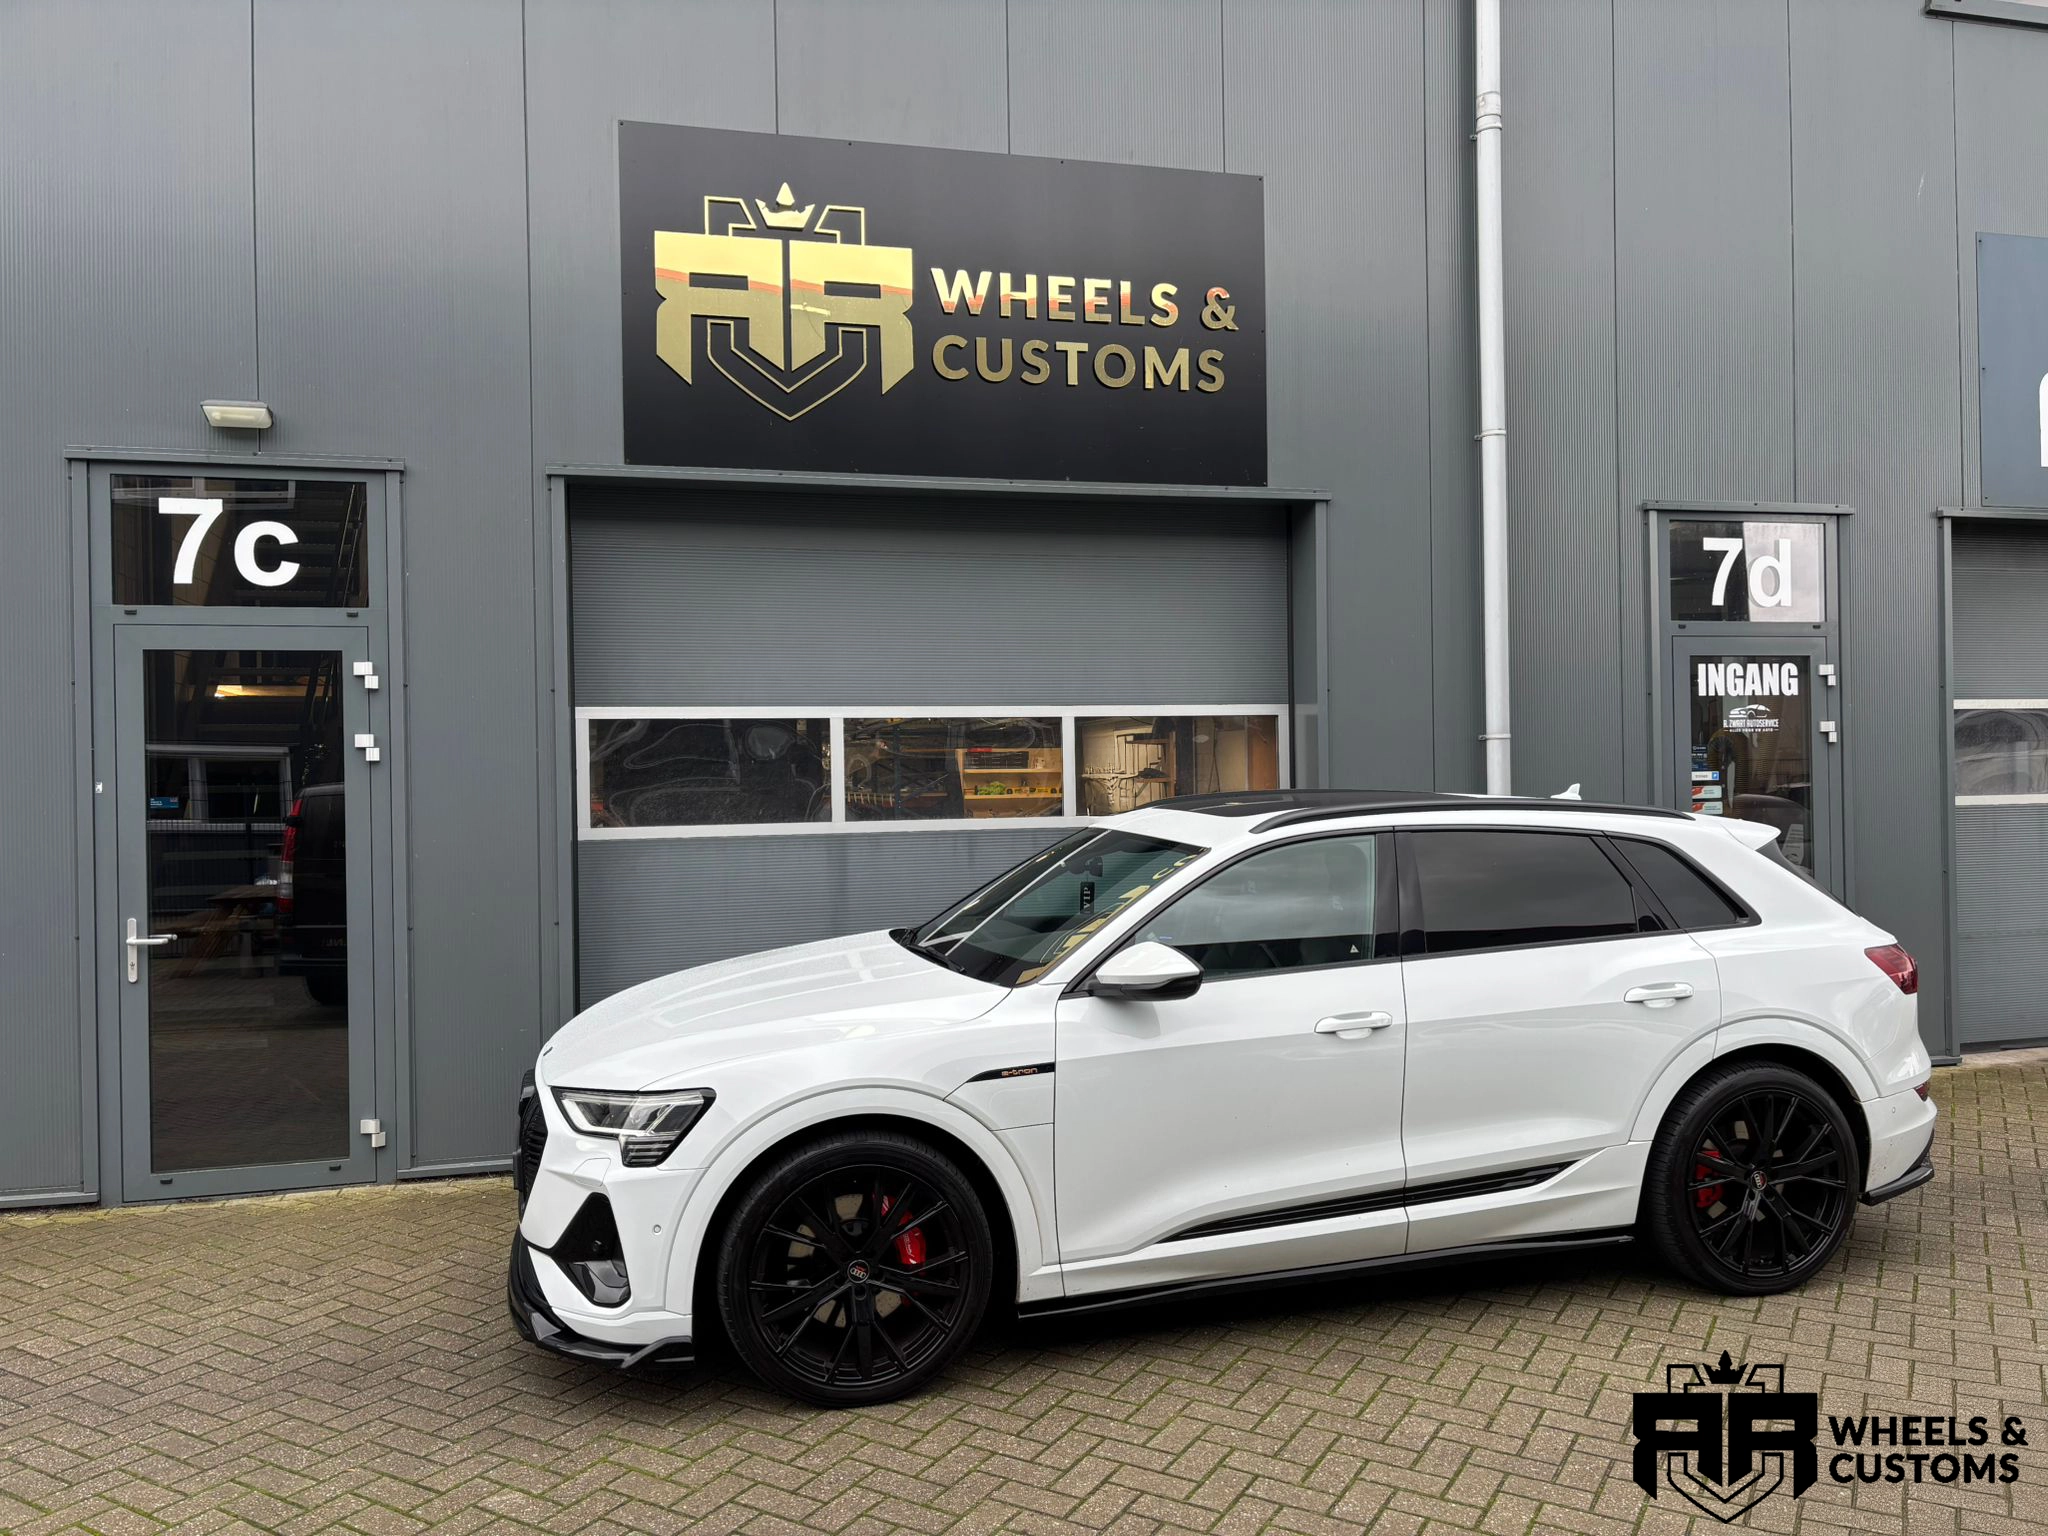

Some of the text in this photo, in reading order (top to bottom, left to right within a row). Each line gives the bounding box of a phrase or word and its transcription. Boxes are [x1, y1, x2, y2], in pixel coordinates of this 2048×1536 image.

[931, 267, 1239, 330] WHEELS &
[932, 334, 1225, 393] CUSTOMS
[158, 497, 300, 587] 7c
[1702, 537, 1792, 608] 7d
[1698, 662, 1799, 697] INGANG
[1001, 1067, 1038, 1077] e-tron
